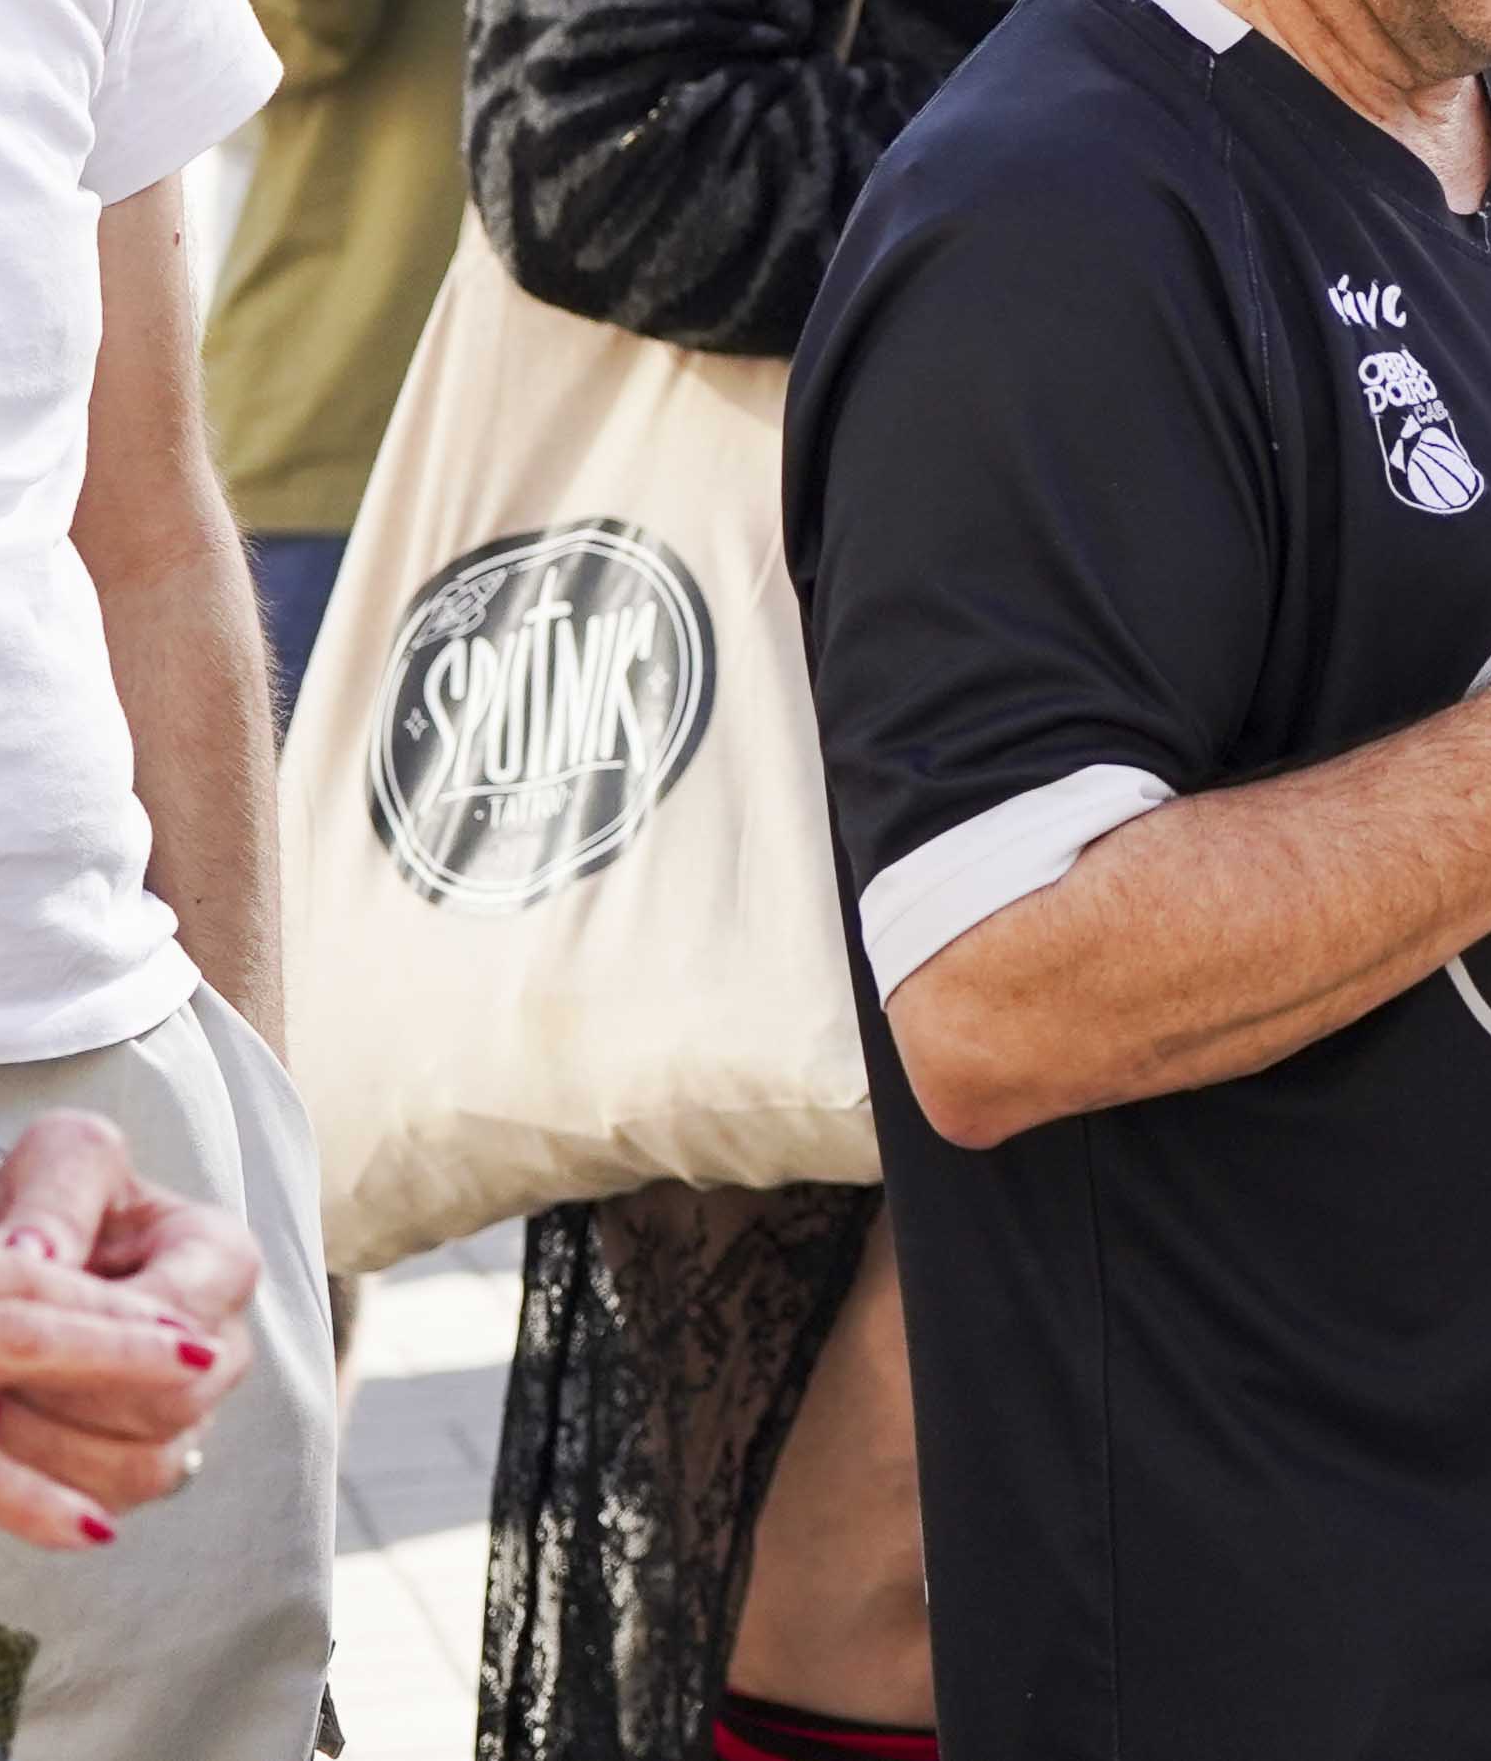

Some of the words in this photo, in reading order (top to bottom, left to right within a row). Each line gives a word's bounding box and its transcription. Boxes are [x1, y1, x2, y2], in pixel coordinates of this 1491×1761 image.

[1358, 346, 1428, 387] OBRA
[1363, 375, 1438, 414] DOIRO
[1413, 399, 1449, 425] CAB
